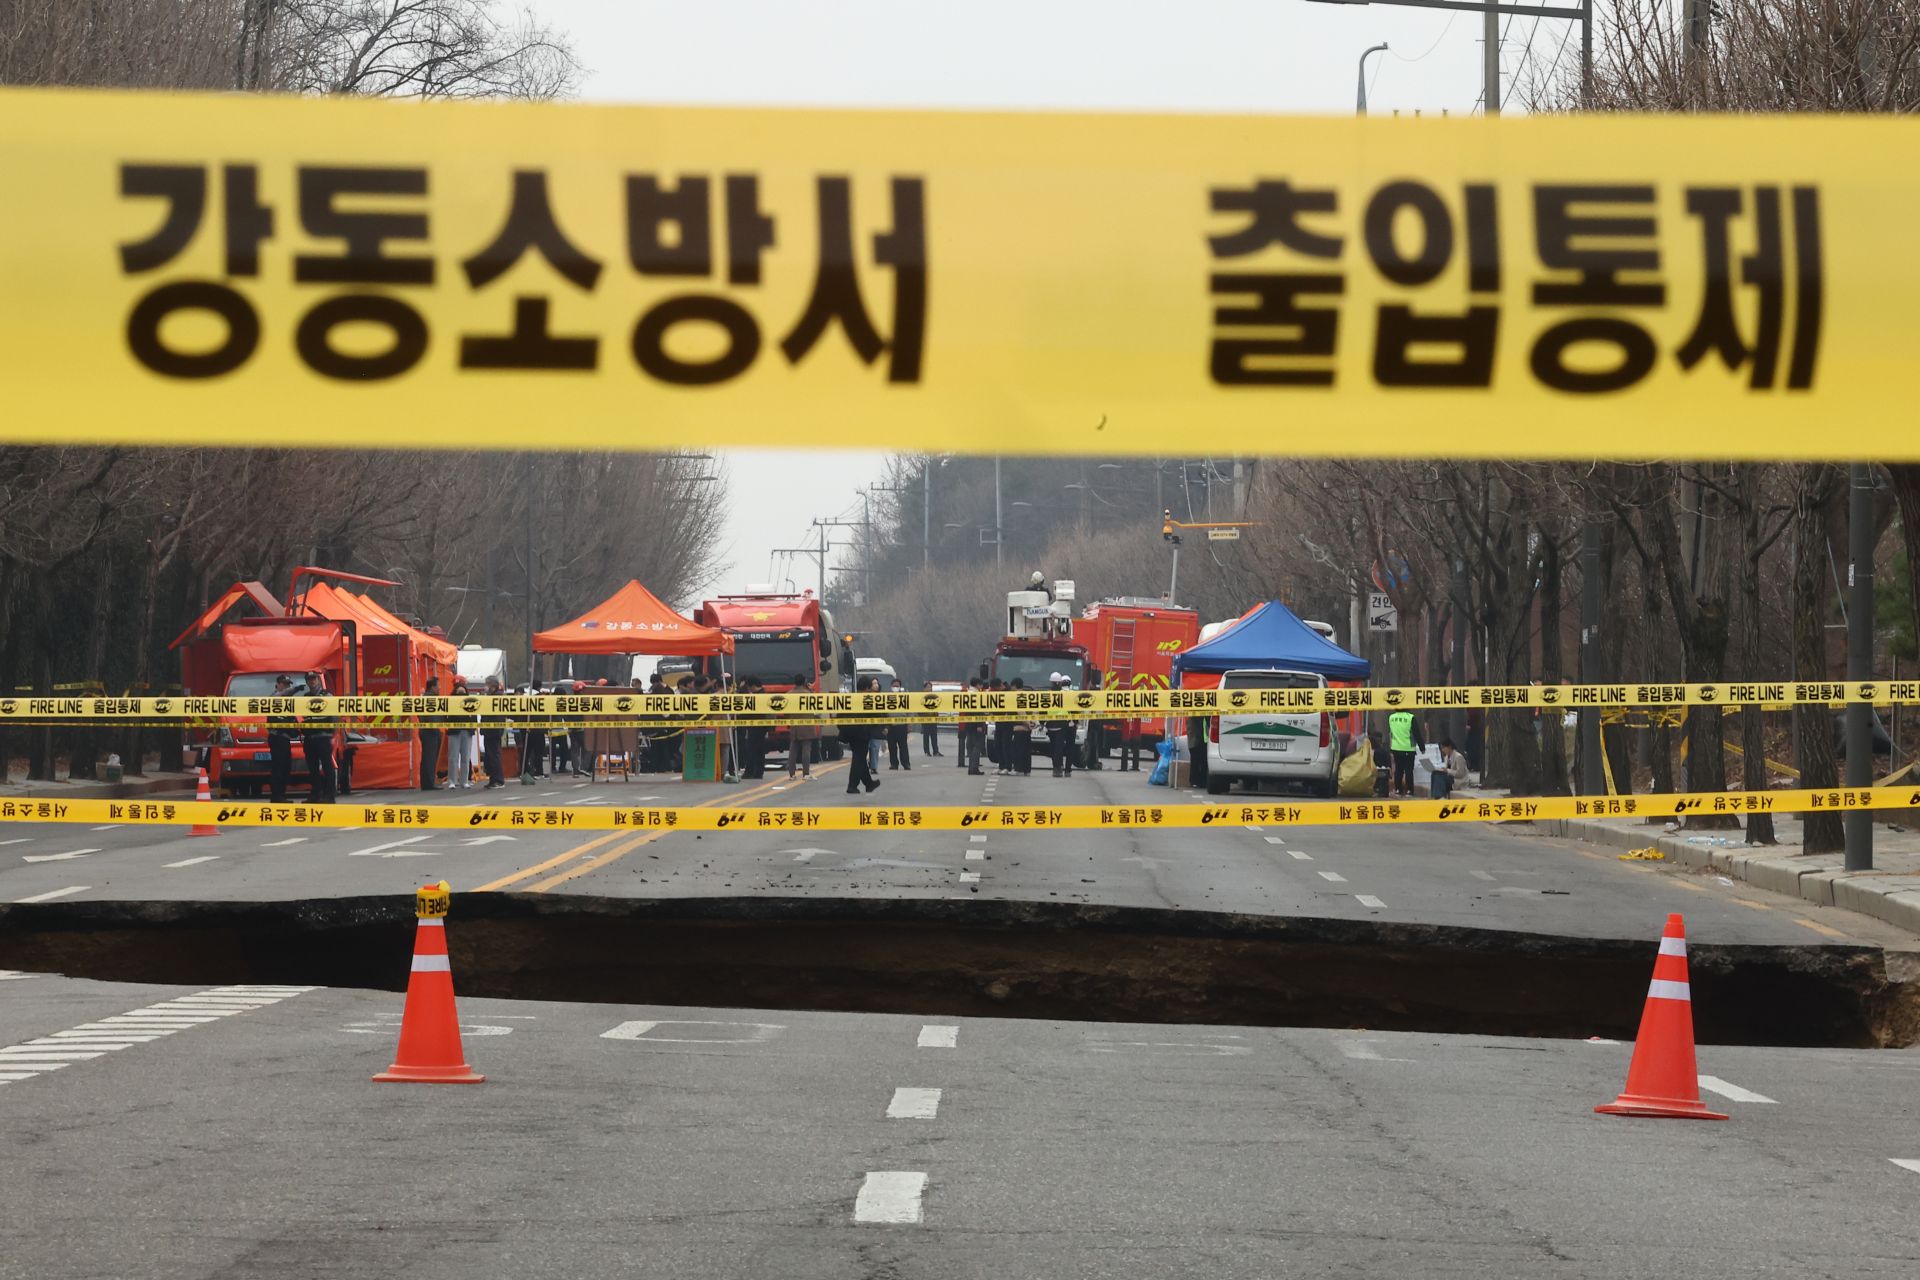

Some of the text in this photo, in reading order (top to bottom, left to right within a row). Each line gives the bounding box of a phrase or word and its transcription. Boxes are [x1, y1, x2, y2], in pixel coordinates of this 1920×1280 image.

[118, 161, 1823, 395] 강동소방서 출입통제
[605, 621, 679, 631] 강동소방서
[1156, 639, 1182, 651] 119
[373, 664, 392, 675] 119
[30, 700, 54, 714] FIRE
[58, 700, 82, 714] LINE
[94, 699, 140, 714] 출입통제
[184, 699, 208, 713] FIRE
[212, 699, 236, 713] LINE
[248, 698, 294, 713] 출입통제
[338, 698, 362, 712] FIRE
[366, 698, 390, 712] LINE
[402, 697, 448, 712] 출입통제
[492, 697, 516, 711] FIRE
[520, 697, 544, 711] LINE
[556, 696, 602, 711] 출입통제
[646, 696, 670, 710] FIRE
[674, 696, 698, 710] LINE
[709, 695, 755, 710] 출입통제
[799, 695, 823, 709] FIRE
[827, 695, 851, 709] LINE
[863, 694, 909, 709] 출입통제
[953, 694, 977, 708] FIRE
[981, 694, 1005, 708] LINE
[1016, 692, 1063, 708] 출입통제
[1107, 692, 1130, 706] FIRE
[1134, 692, 1158, 706] LINE
[1170, 691, 1216, 706] 출입통제
[1261, 690, 1284, 704] FIRE
[1288, 690, 1313, 704] LINE
[1325, 690, 1371, 704] 출입통제
[1416, 689, 1440, 703] FIRE
[1444, 689, 1469, 703] LINE
[1481, 688, 1528, 703] 출입통제
[1573, 687, 1597, 701] FIRE
[1601, 687, 1626, 701] LINE
[1638, 686, 1685, 701] 출입통제
[1730, 685, 1755, 699] FIRE
[1759, 685, 1784, 699] LINE
[1796, 684, 1844, 699] 출입통제
[1890, 683, 1915, 699] FIRE
[1577, 799, 1636, 815] 출입통제
[1714, 795, 1773, 811] 서울소방
[1812, 792, 1872, 808] 출입통제
[2, 801, 67, 816] 서울소방
[110, 804, 174, 820] 출입통제
[260, 807, 323, 822] 서울소방
[1242, 807, 1301, 822] 서울소방
[1340, 805, 1400, 820] 출입통제
[1479, 802, 1538, 818] 서울소방
[365, 809, 428, 824] 출입통제
[512, 811, 573, 825] 서울소방
[615, 811, 677, 825] 출입통제
[759, 811, 819, 826] 서울소방
[860, 811, 921, 825] 출입통제
[1002, 810, 1062, 825] 서울소방
[1102, 809, 1162, 824] 출입통제
[428, 896, 447, 915] FIRE
